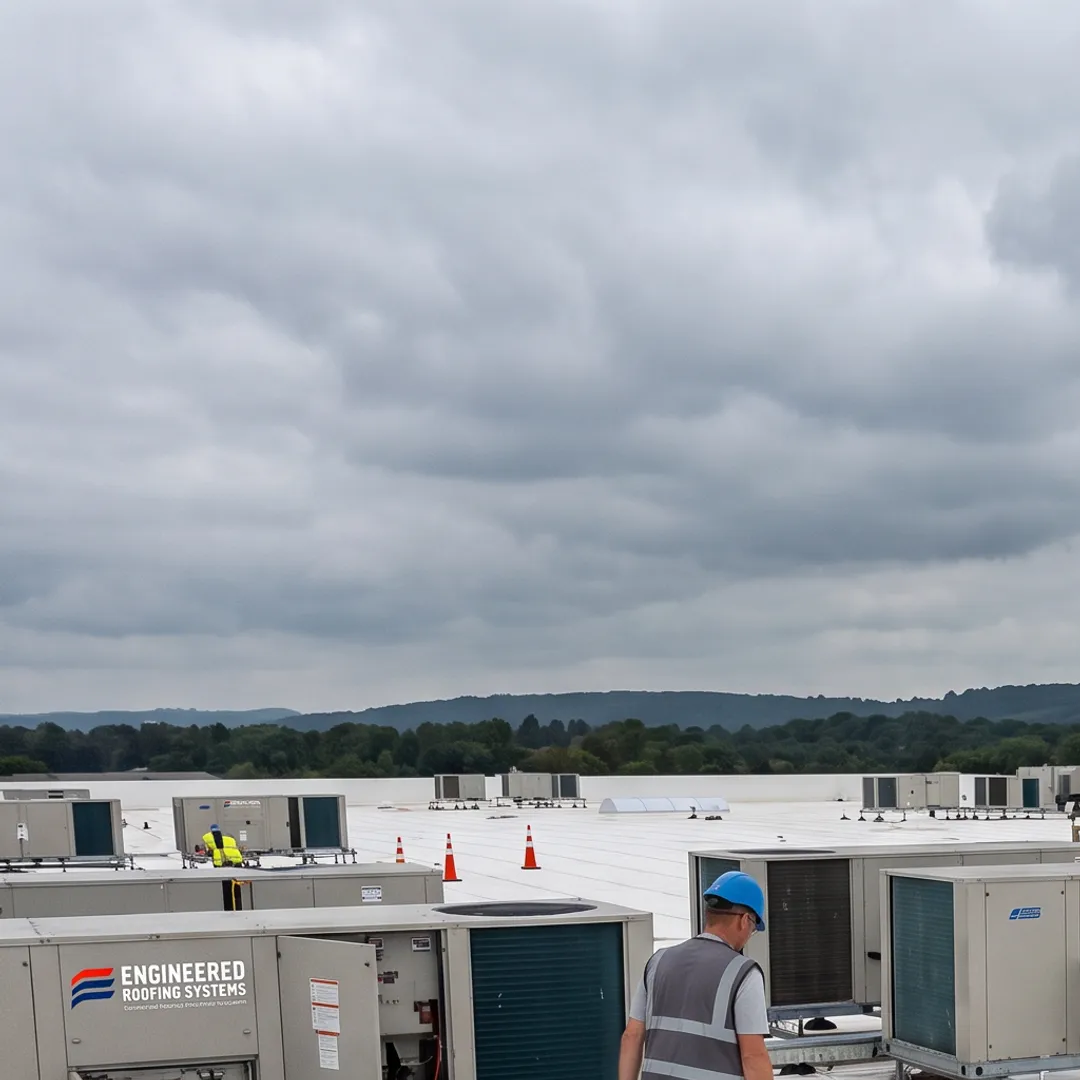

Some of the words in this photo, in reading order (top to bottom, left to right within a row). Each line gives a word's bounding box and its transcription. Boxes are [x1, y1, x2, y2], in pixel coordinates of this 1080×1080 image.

[121, 960, 245, 986] ENGINEERED
[122, 986, 181, 1002] ROOFING
[184, 982, 247, 998] SYSTEMS
